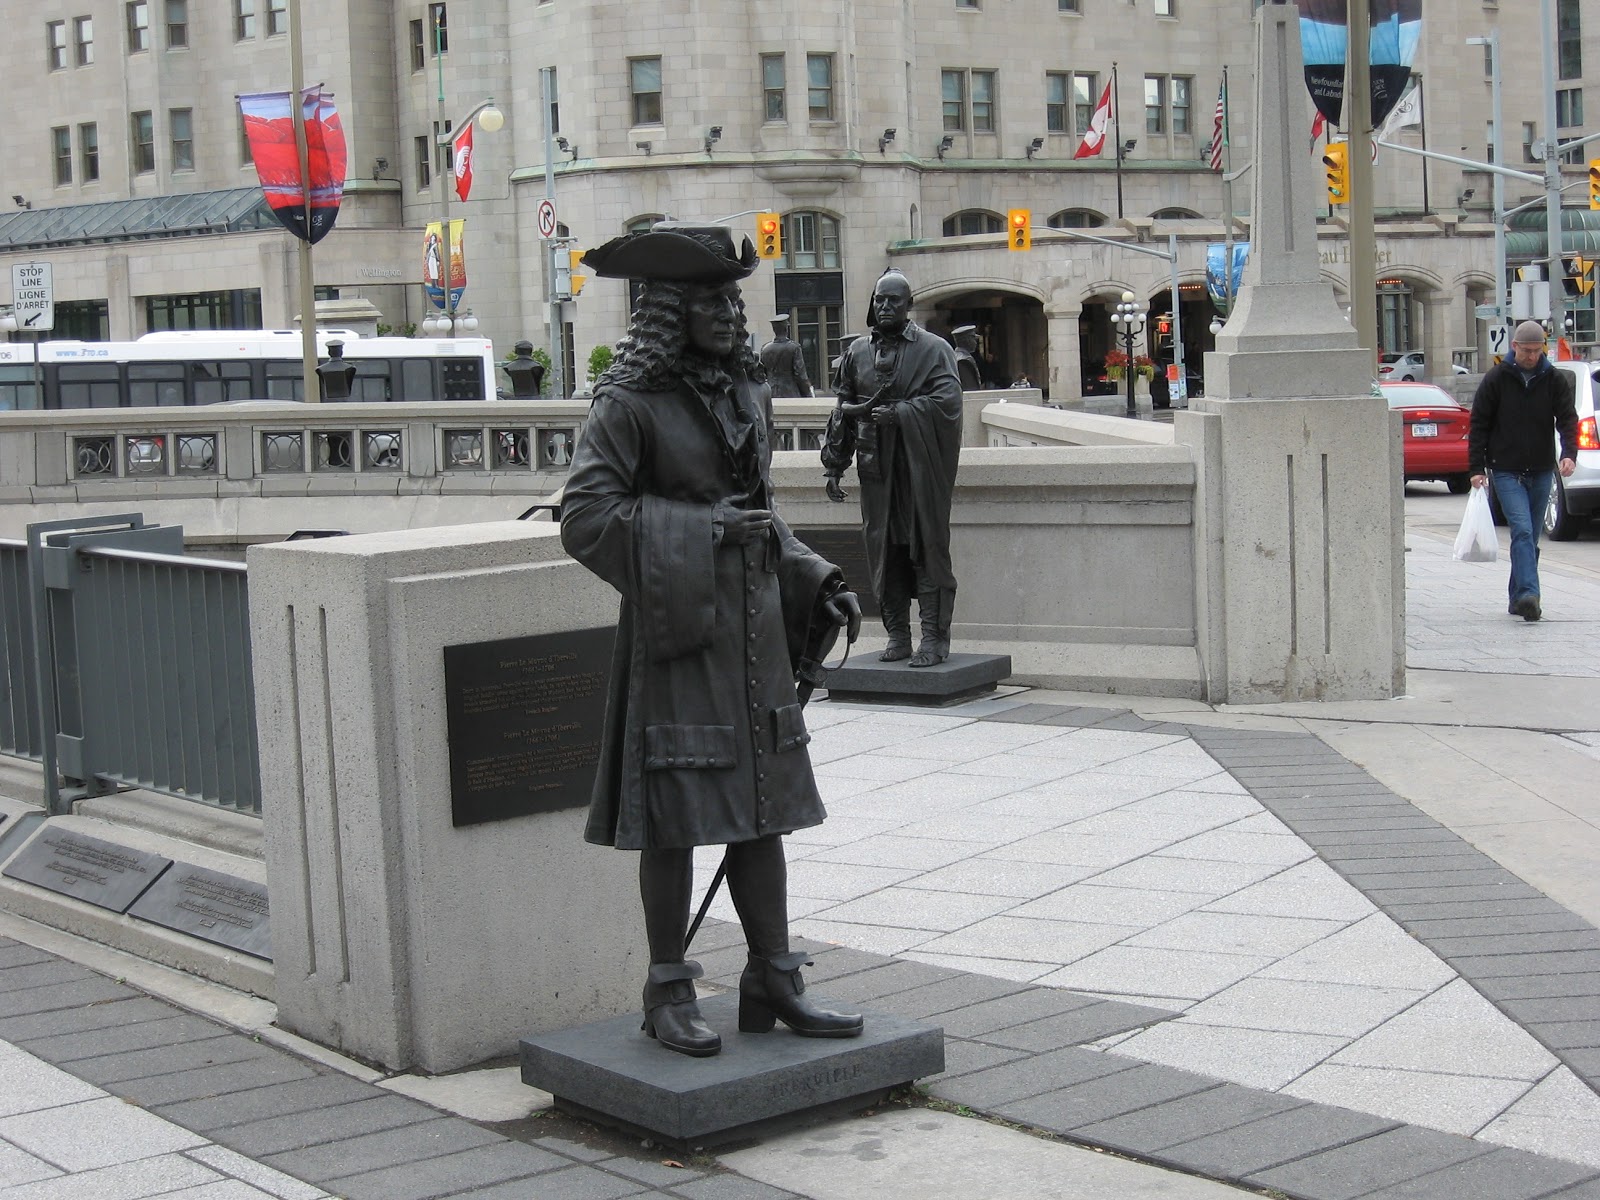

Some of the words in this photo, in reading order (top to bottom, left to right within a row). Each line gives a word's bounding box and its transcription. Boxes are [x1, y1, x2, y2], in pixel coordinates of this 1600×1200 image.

[1323, 88, 1344, 99] Labrad
[20, 268, 43, 277] STOP
[22, 278, 42, 286] LINE
[19, 290, 46, 299] LIGNE
[0, 351, 12, 360] 06
